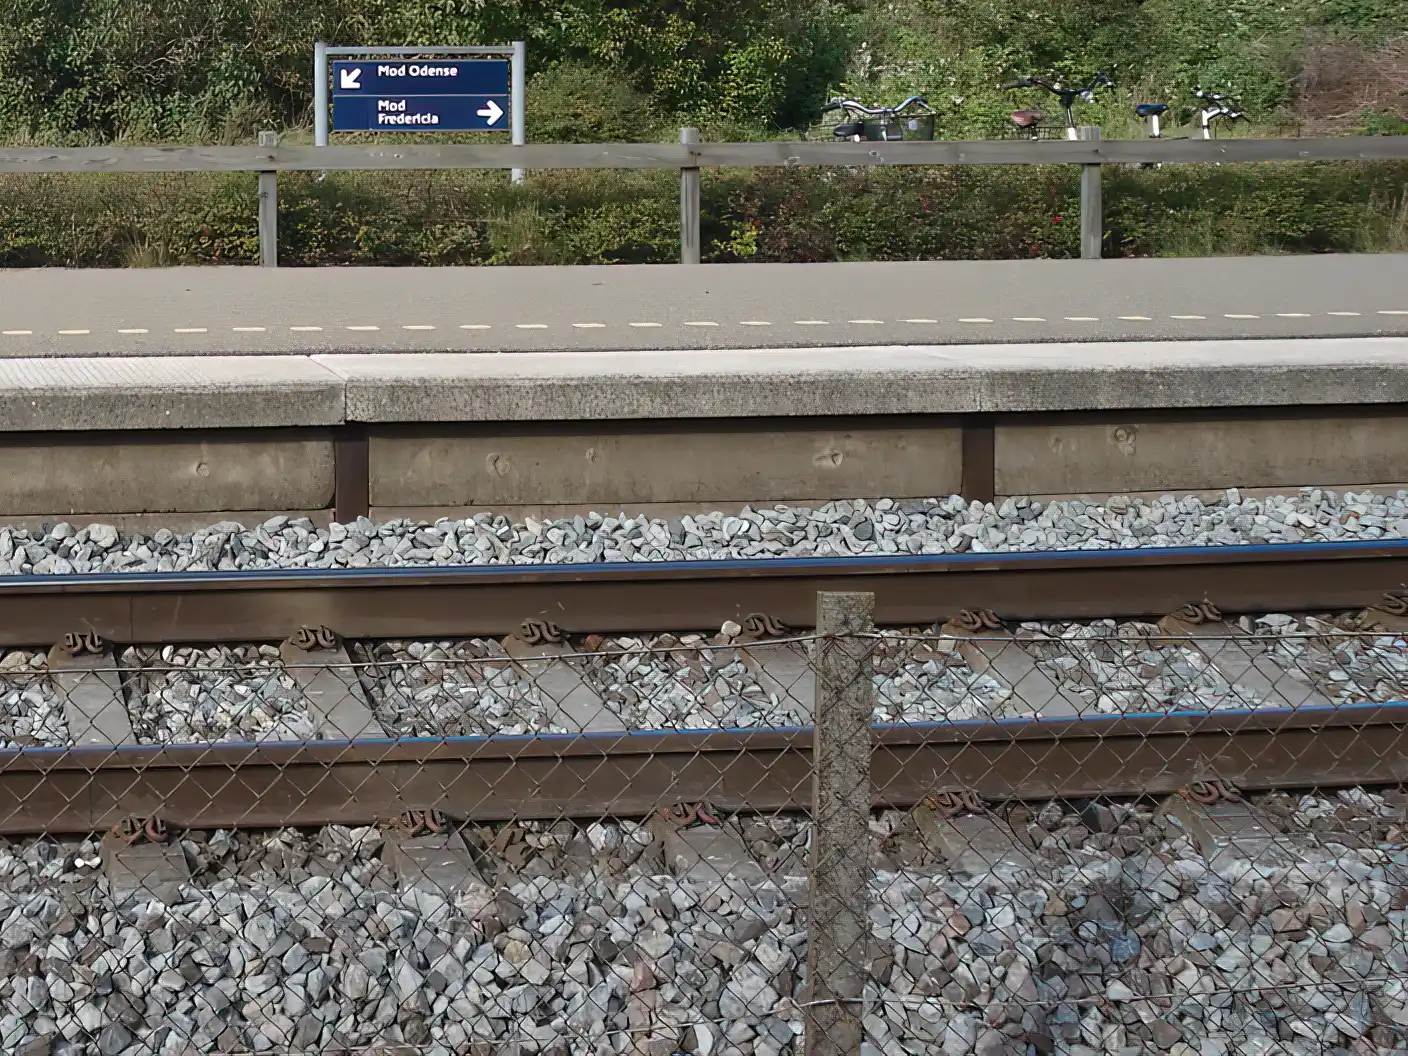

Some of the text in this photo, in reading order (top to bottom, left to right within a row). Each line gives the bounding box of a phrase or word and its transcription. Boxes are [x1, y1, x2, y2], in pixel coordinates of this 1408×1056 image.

[378, 65, 458, 76] Mod Odense
[378, 100, 406, 111] Mod
[378, 113, 438, 124] Fredericia
